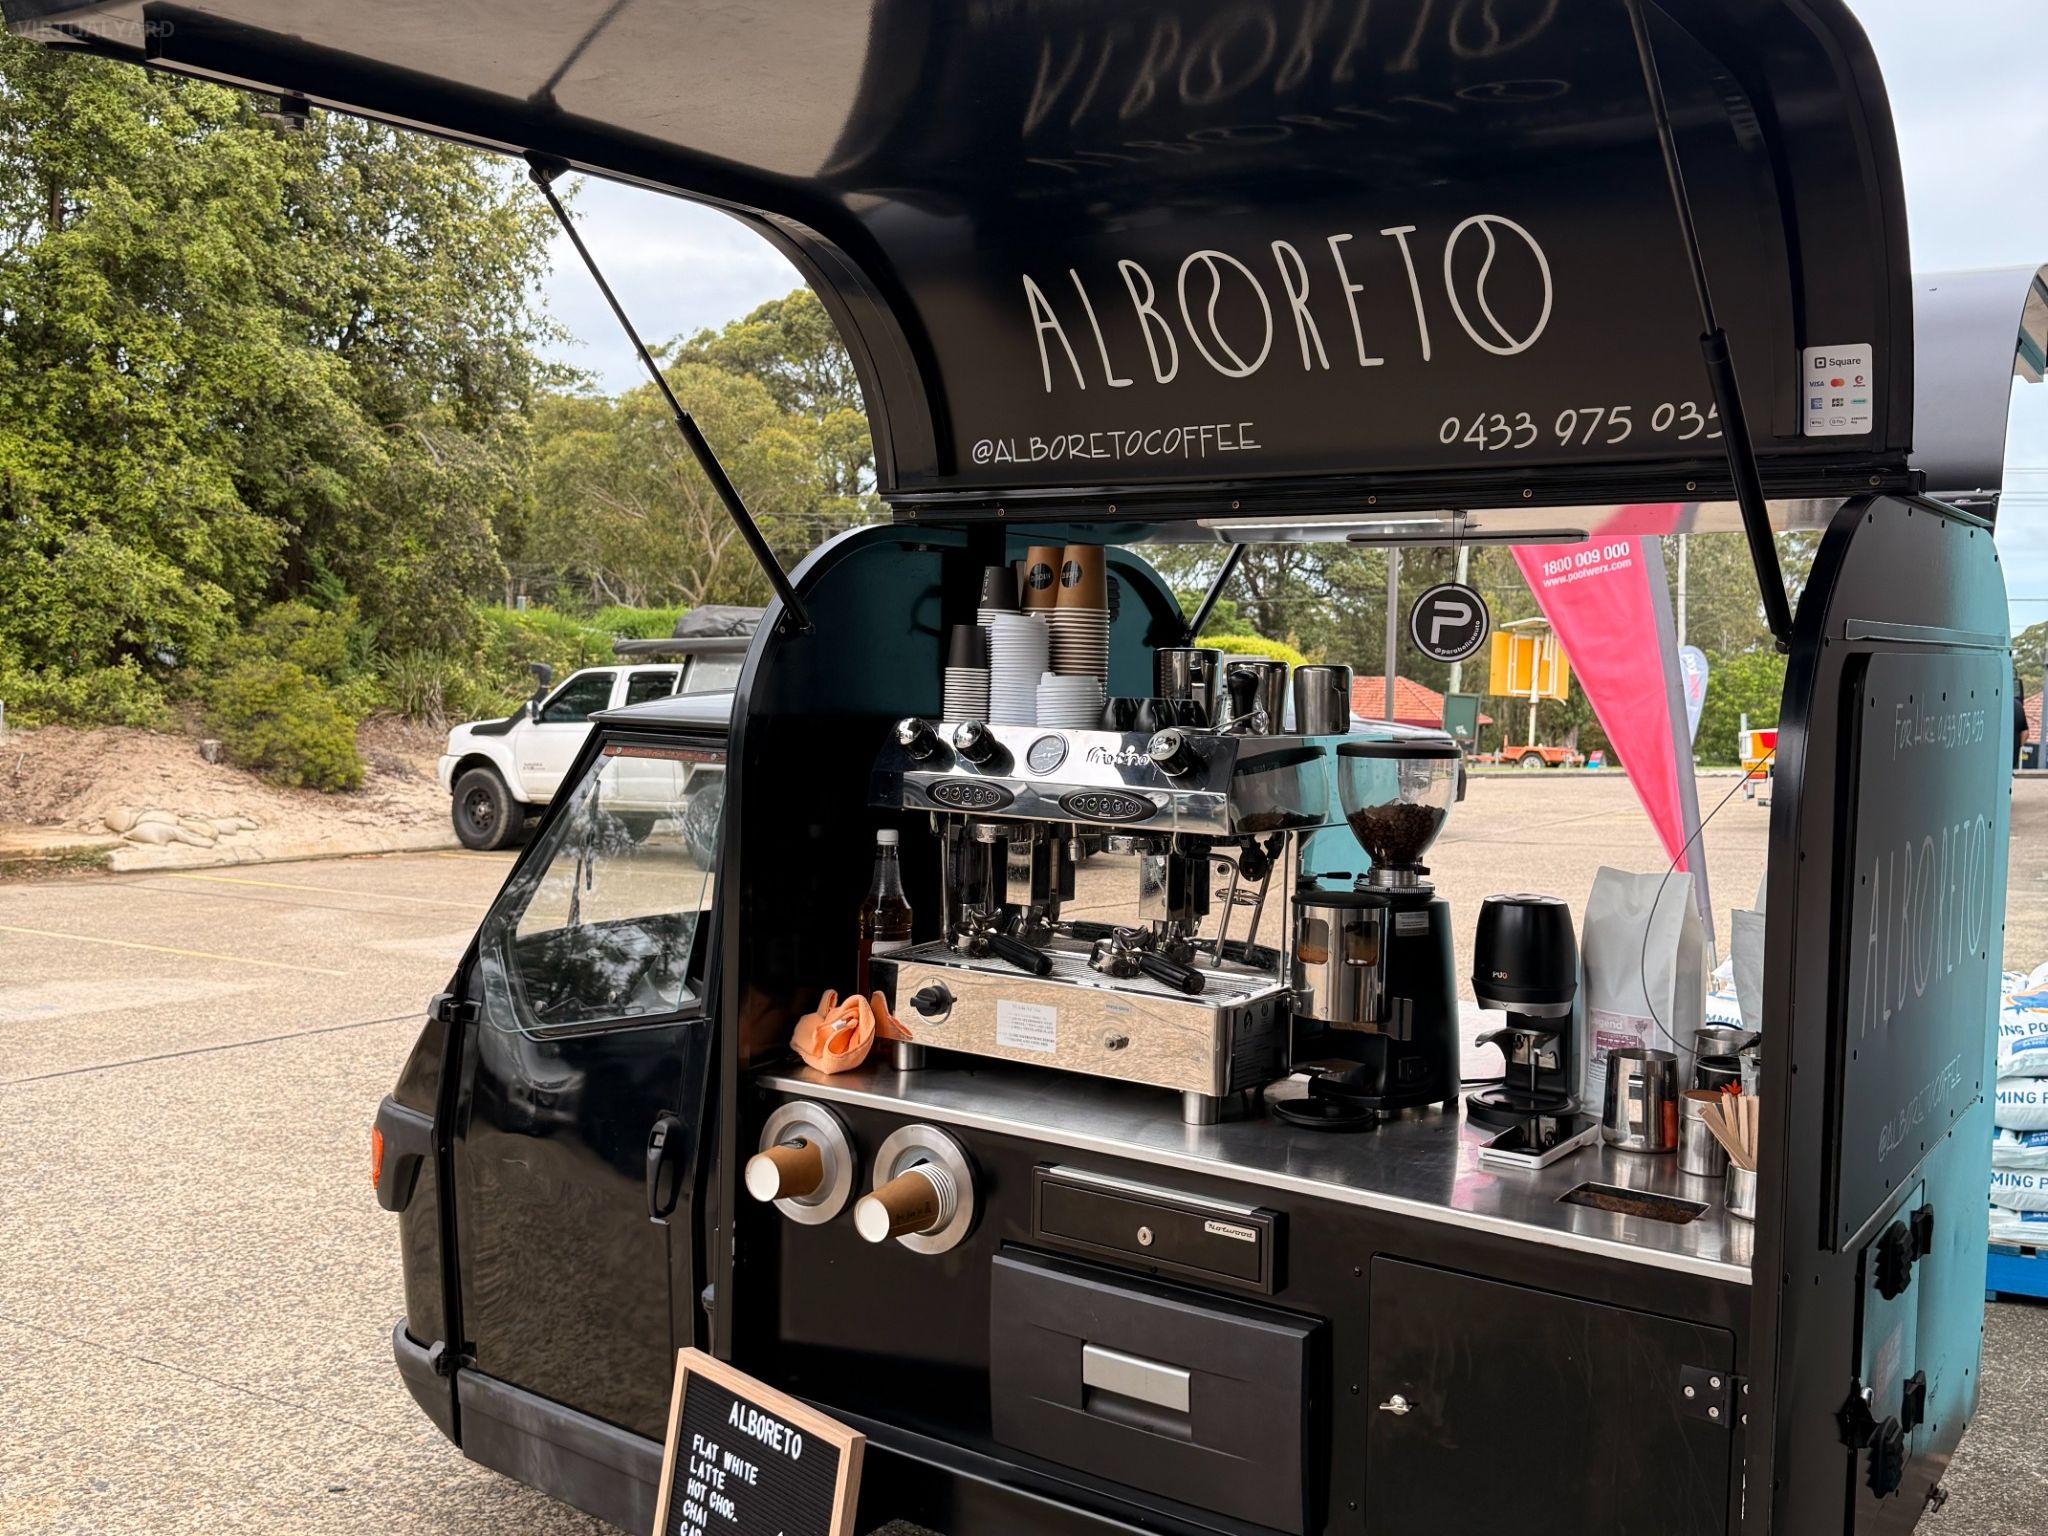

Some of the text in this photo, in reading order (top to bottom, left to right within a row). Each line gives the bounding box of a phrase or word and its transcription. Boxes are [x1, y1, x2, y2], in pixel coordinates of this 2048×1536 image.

[1022, 214, 1553, 393] ALBORETO
[1829, 358, 1862, 367] Square
[972, 422, 1262, 464] @ALBORETOCOFFEE
[1439, 402, 1538, 451] 0433
[1554, 405, 1632, 446] 975
[1543, 541, 1630, 577] 1800 009 000
[1543, 559, 1632, 588] www.poolwerx.com
[1861, 813, 1987, 1041] ALBORETO
[728, 1401, 803, 1460] ALBORETO
[689, 1456, 726, 1490] LATTE
[692, 1434, 759, 1486] FLAT WHITE
[683, 1499, 708, 1527] CHAI
[686, 1477, 738, 1523] HOT CHOC.
